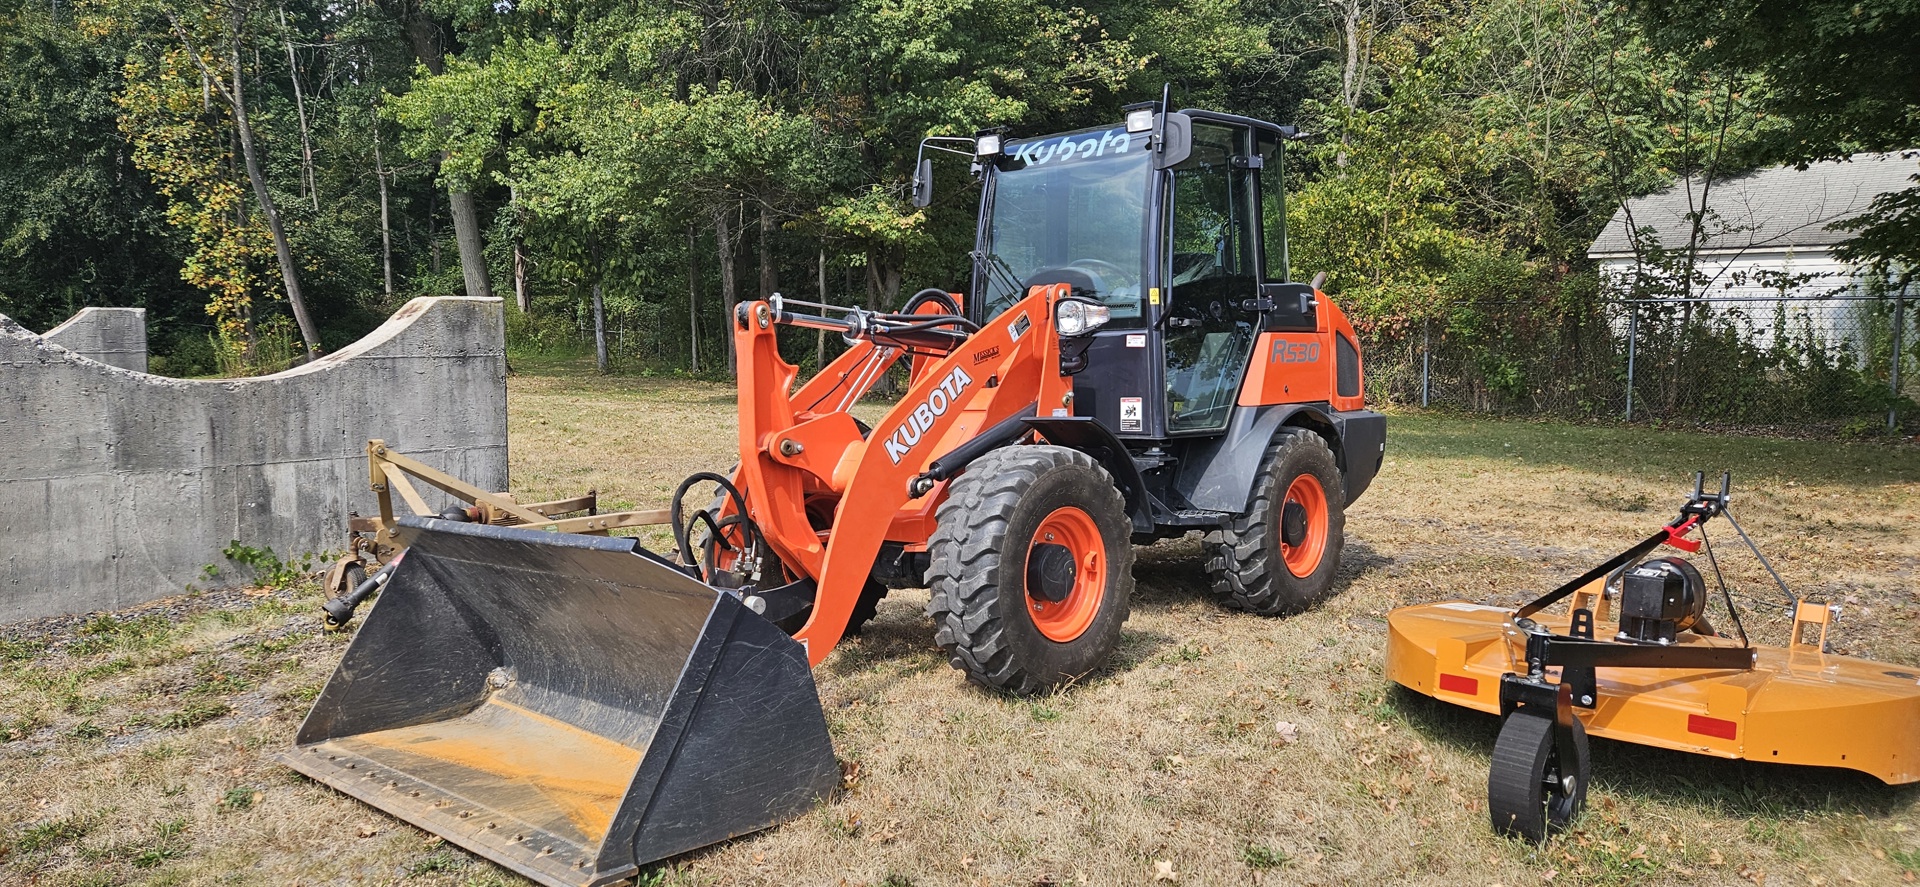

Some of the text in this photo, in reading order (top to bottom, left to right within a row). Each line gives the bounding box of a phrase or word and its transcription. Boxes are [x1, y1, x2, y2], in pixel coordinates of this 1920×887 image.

[1014, 130, 1131, 166] Kubota
[1271, 339, 1320, 363] R530
[884, 365, 972, 465] KUBOTA
